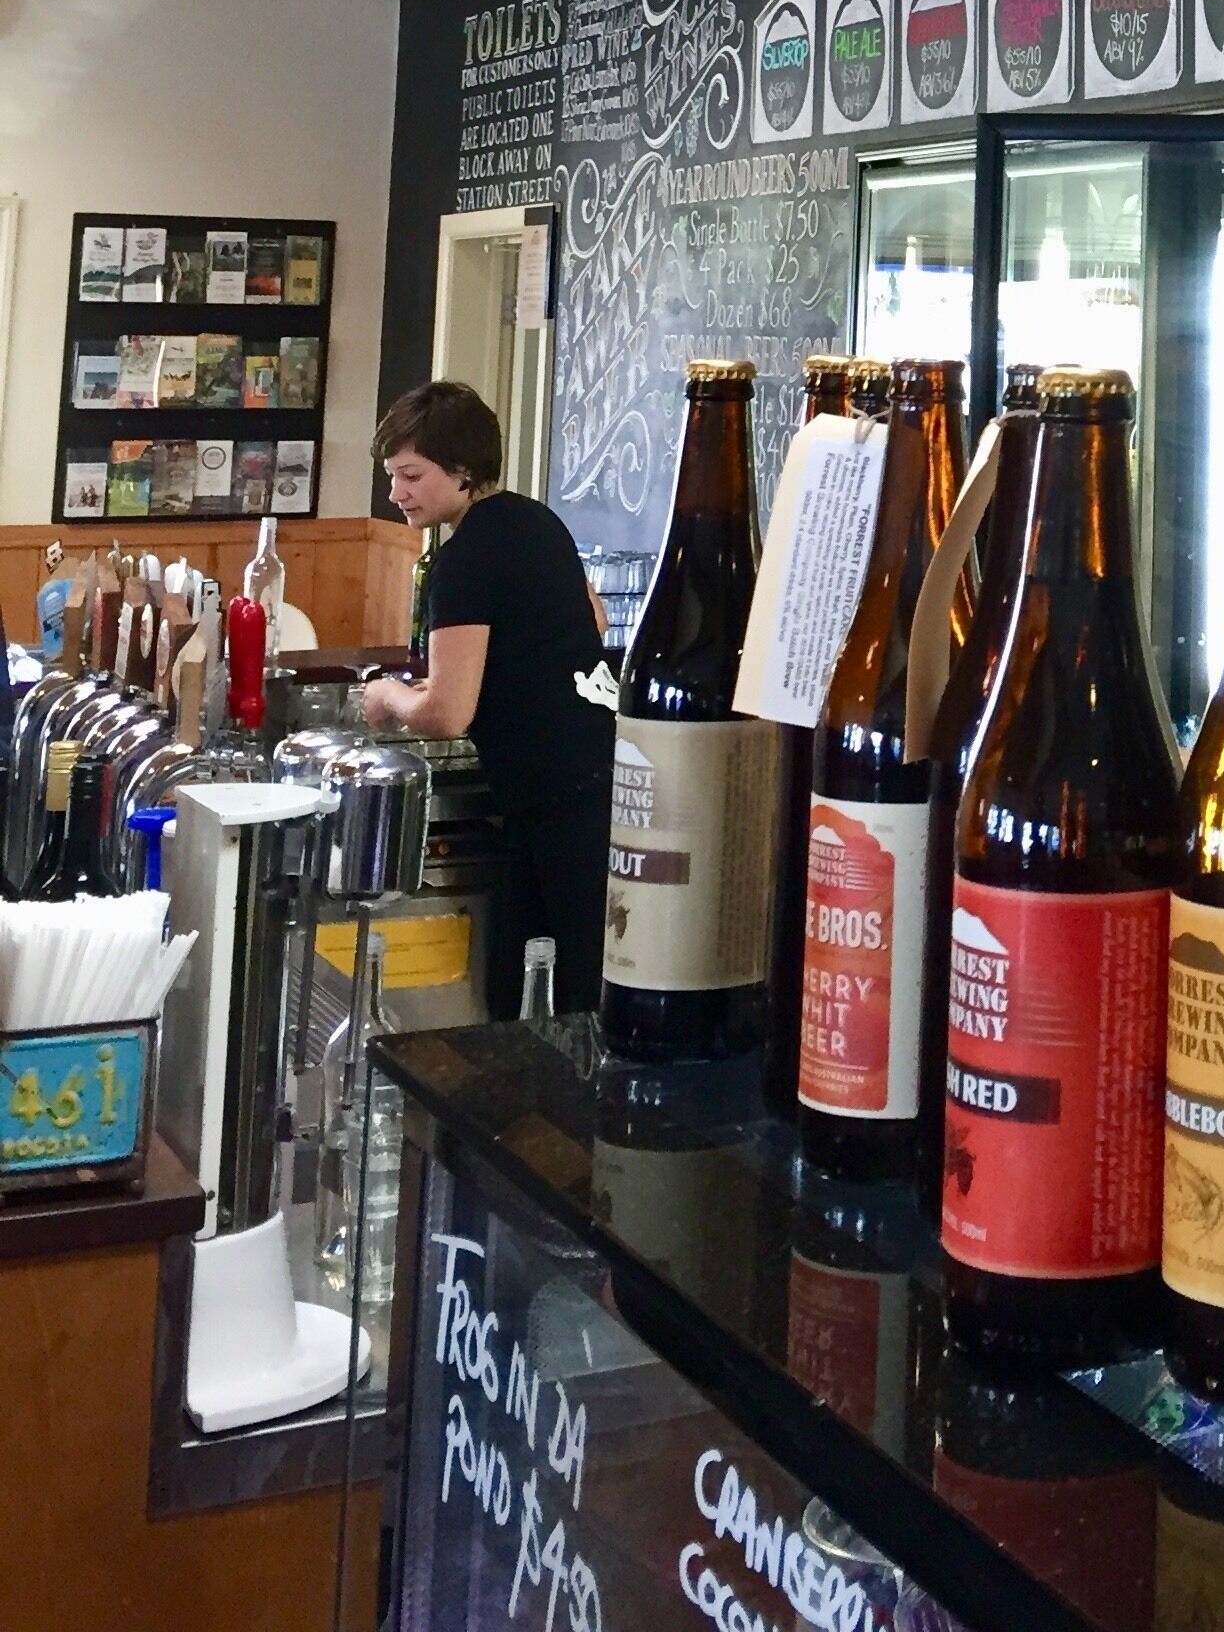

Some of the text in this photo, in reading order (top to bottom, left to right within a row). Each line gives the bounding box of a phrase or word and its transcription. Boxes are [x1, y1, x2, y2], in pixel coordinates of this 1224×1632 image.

[860, 27, 882, 59] ALE
[1110, 10, 1149, 37] $10/15
[461, 66, 478, 90] FOR
[478, 54, 533, 86] CUSTOMERS
[533, 46, 561, 76] ONLY
[1103, 36, 1145, 72] ABV 9%
[462, 89, 502, 122] PUBLIC
[506, 77, 557, 112] TOILETS
[459, 126, 479, 152] ARE
[480, 116, 529, 147] LOCATED
[532, 109, 554, 138] ONE
[458, 143, 553, 181] BLOCK AWAY ON
[668, 146, 850, 205] YEAR ROUND BEERS 500ML
[456, 176, 553, 212] STATION STREET
[689, 210, 727, 246] Single
[774, 199, 820, 243] $7.50
[570, 162, 657, 344] TAKE
[765, 244, 800, 285] $25
[706, 288, 793, 329] Dozen $68
[613, 767, 655, 788] REST
[609, 846, 646, 877] OUT
[818, 904, 888, 951] BROS.
[963, 1073, 1018, 1113] RED
[506, 1340, 539, 1452] IN
[694, 1448, 875, 1632] CRANBERR
